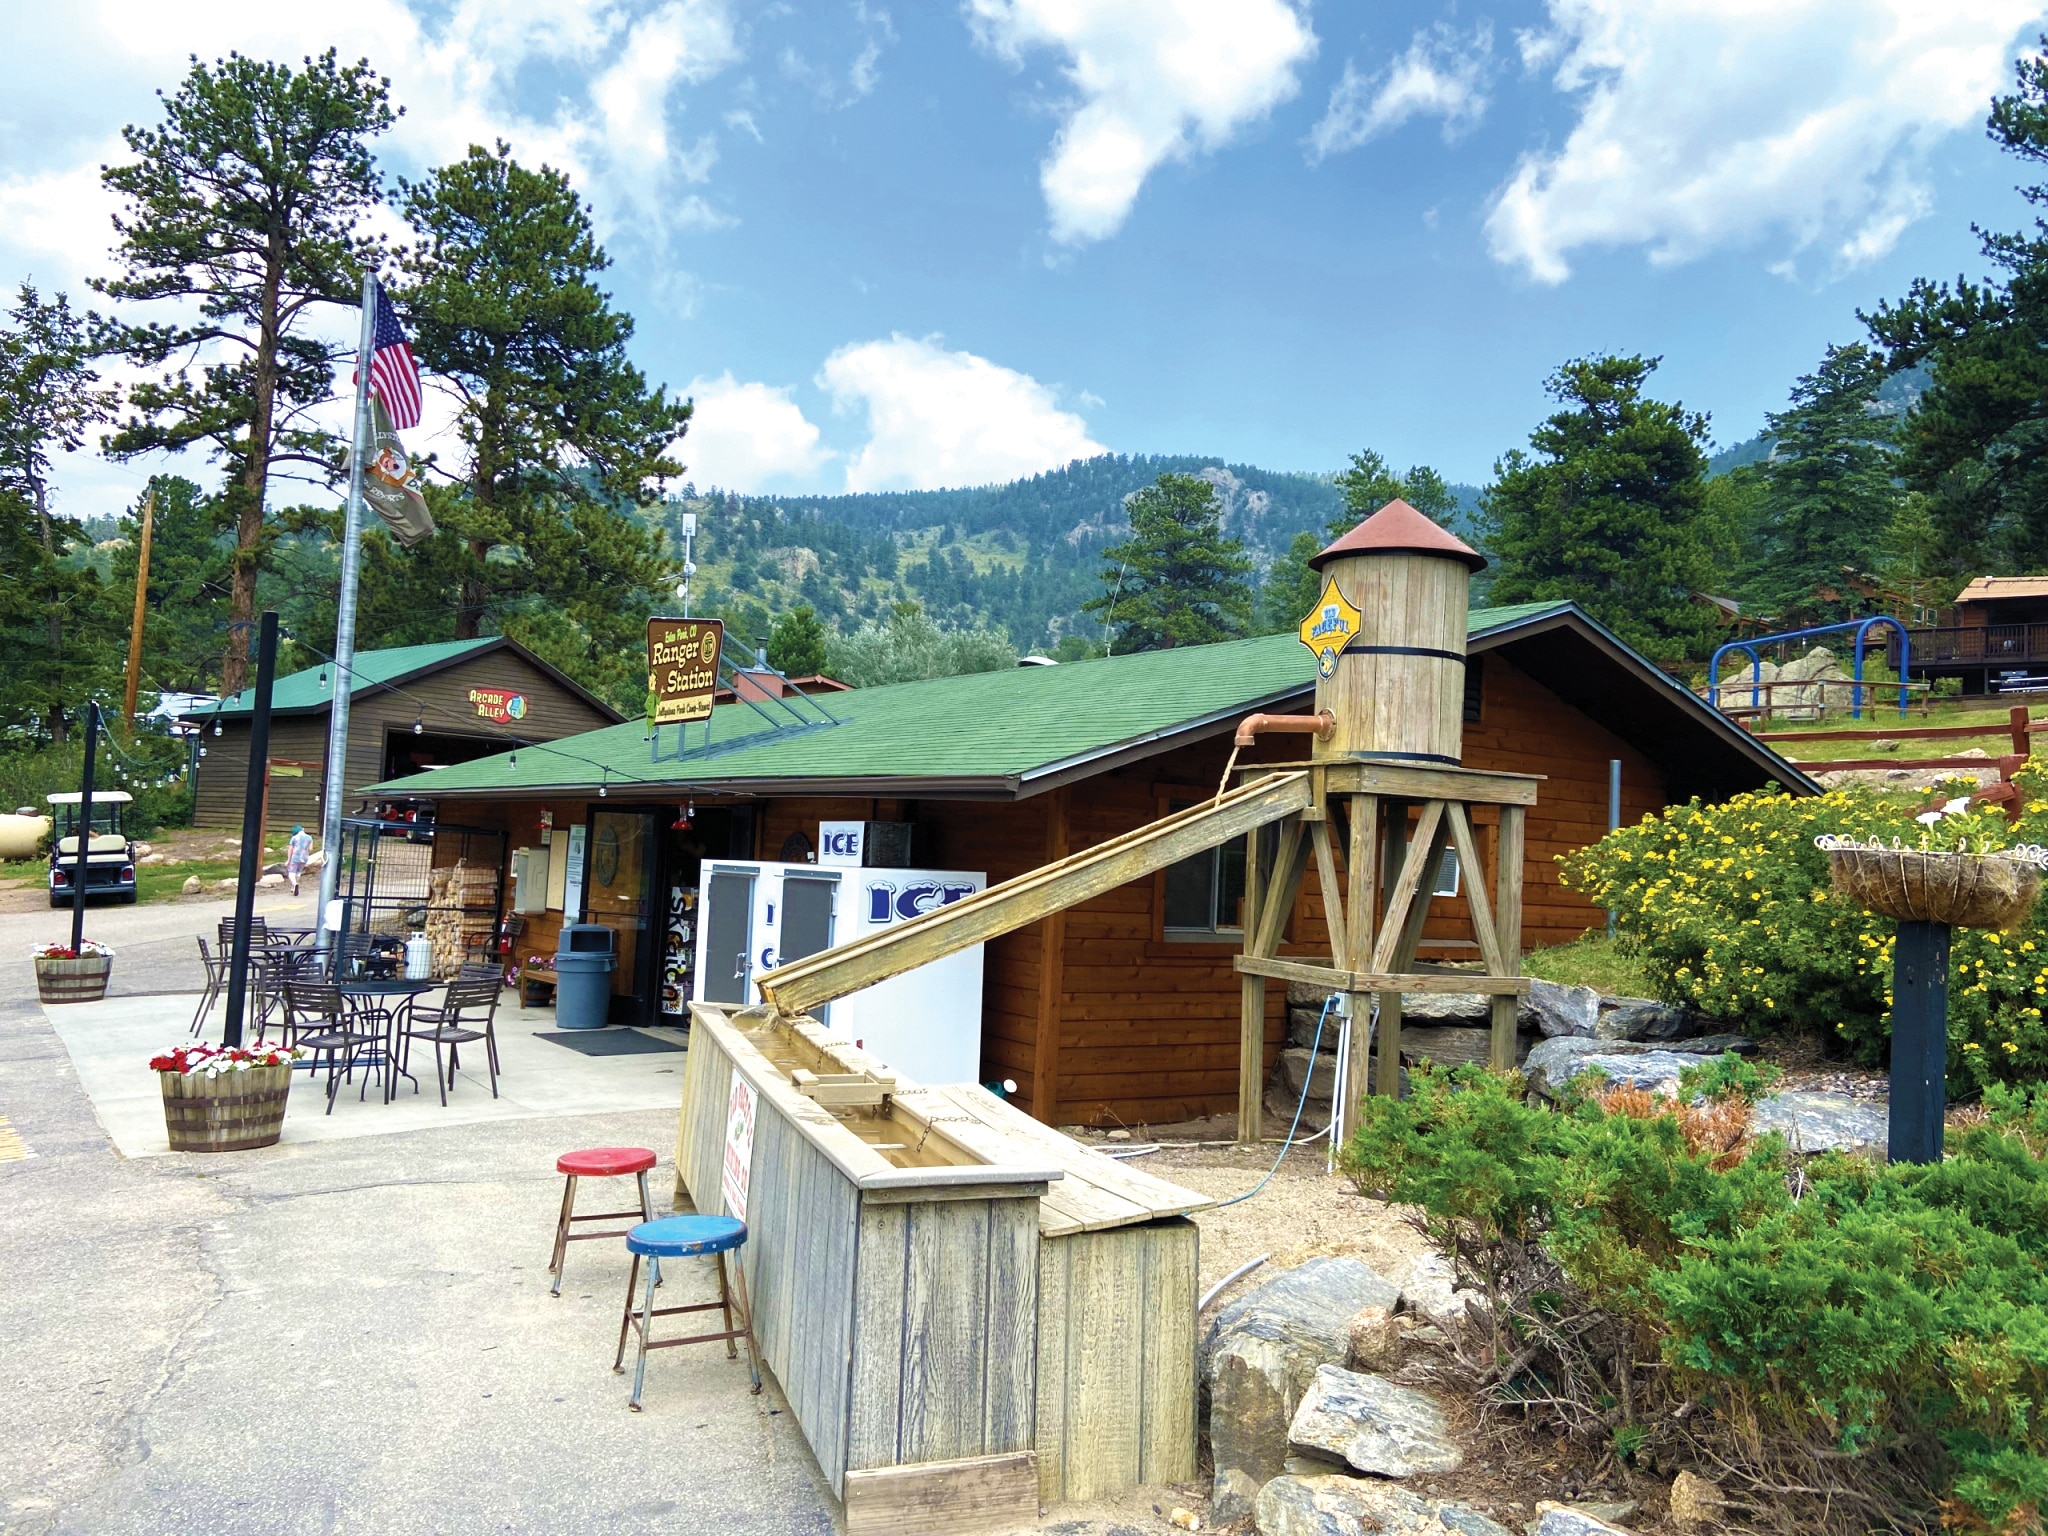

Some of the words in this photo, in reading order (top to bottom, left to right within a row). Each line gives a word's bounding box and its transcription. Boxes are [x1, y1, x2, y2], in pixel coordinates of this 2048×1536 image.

[652, 641, 700, 668] Ranger
[667, 666, 713, 693] Station
[469, 689, 504, 705] ARCADE
[478, 704, 505, 718] ALLEY
[823, 830, 858, 856] ICE
[760, 900, 777, 970] IC
